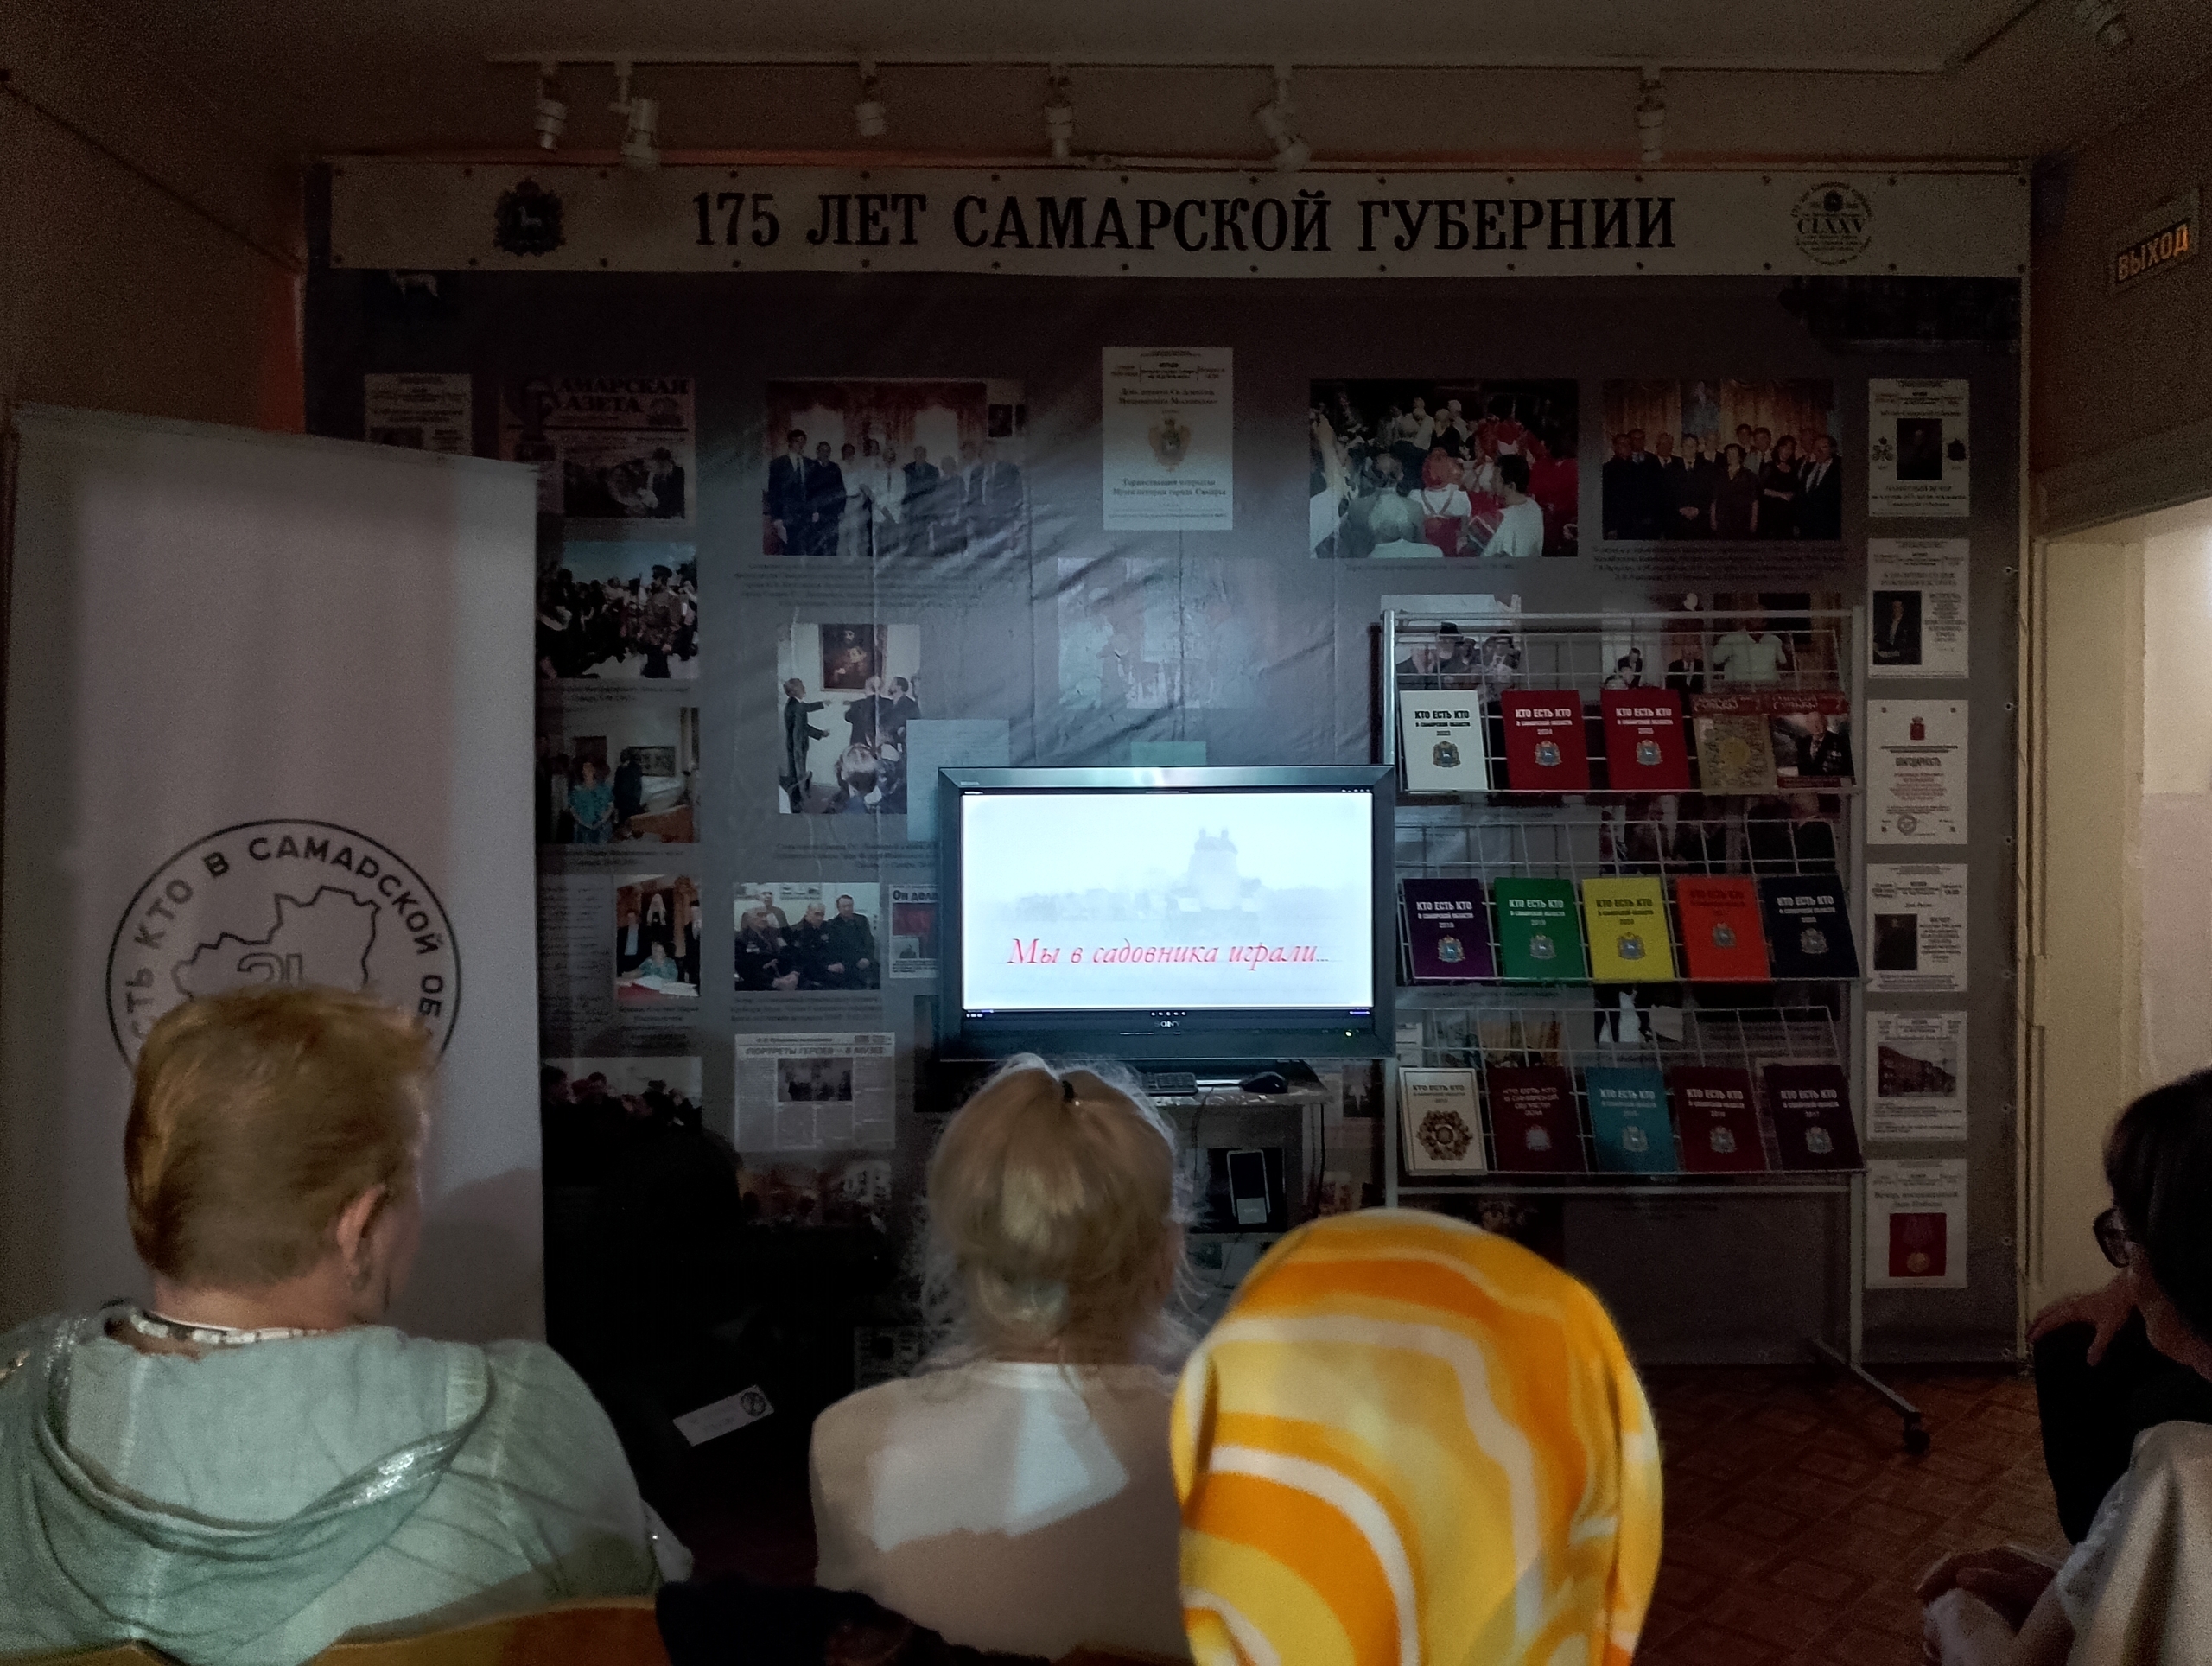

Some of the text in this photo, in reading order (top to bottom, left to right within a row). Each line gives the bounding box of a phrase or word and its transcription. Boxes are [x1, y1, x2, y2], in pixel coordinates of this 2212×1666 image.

[693, 188, 1676, 253] 175 ЛЕТ САМАРСКОЙ ГУБЕРНИИ
[2117, 223, 2190, 282] ВЫХОД
[559, 378, 689, 395] АМАРСКАЯ
[566, 395, 644, 413] АЗЕТА
[1414, 710, 1470, 719] КТО ЕСТЬ КТО
[1515, 709, 1572, 718] КТО ЕСТЬ КТО
[1615, 707, 1672, 717] КТО ЕСТЬ КТО
[133, 878, 194, 950] КТО
[202, 851, 230, 879] В
[248, 835, 442, 956] САМАРСКОЙ
[1777, 895, 1834, 906] КТО ЕСТЬ КТО
[1415, 900, 1472, 911] КТО ЕСТЬ КТО
[1509, 899, 1564, 908] КТО ЕСТЬ КТО
[1596, 899, 1652, 908] КТО ЕСТЬ КТО
[1006, 938, 1331, 972] Мы в садовника играли...
